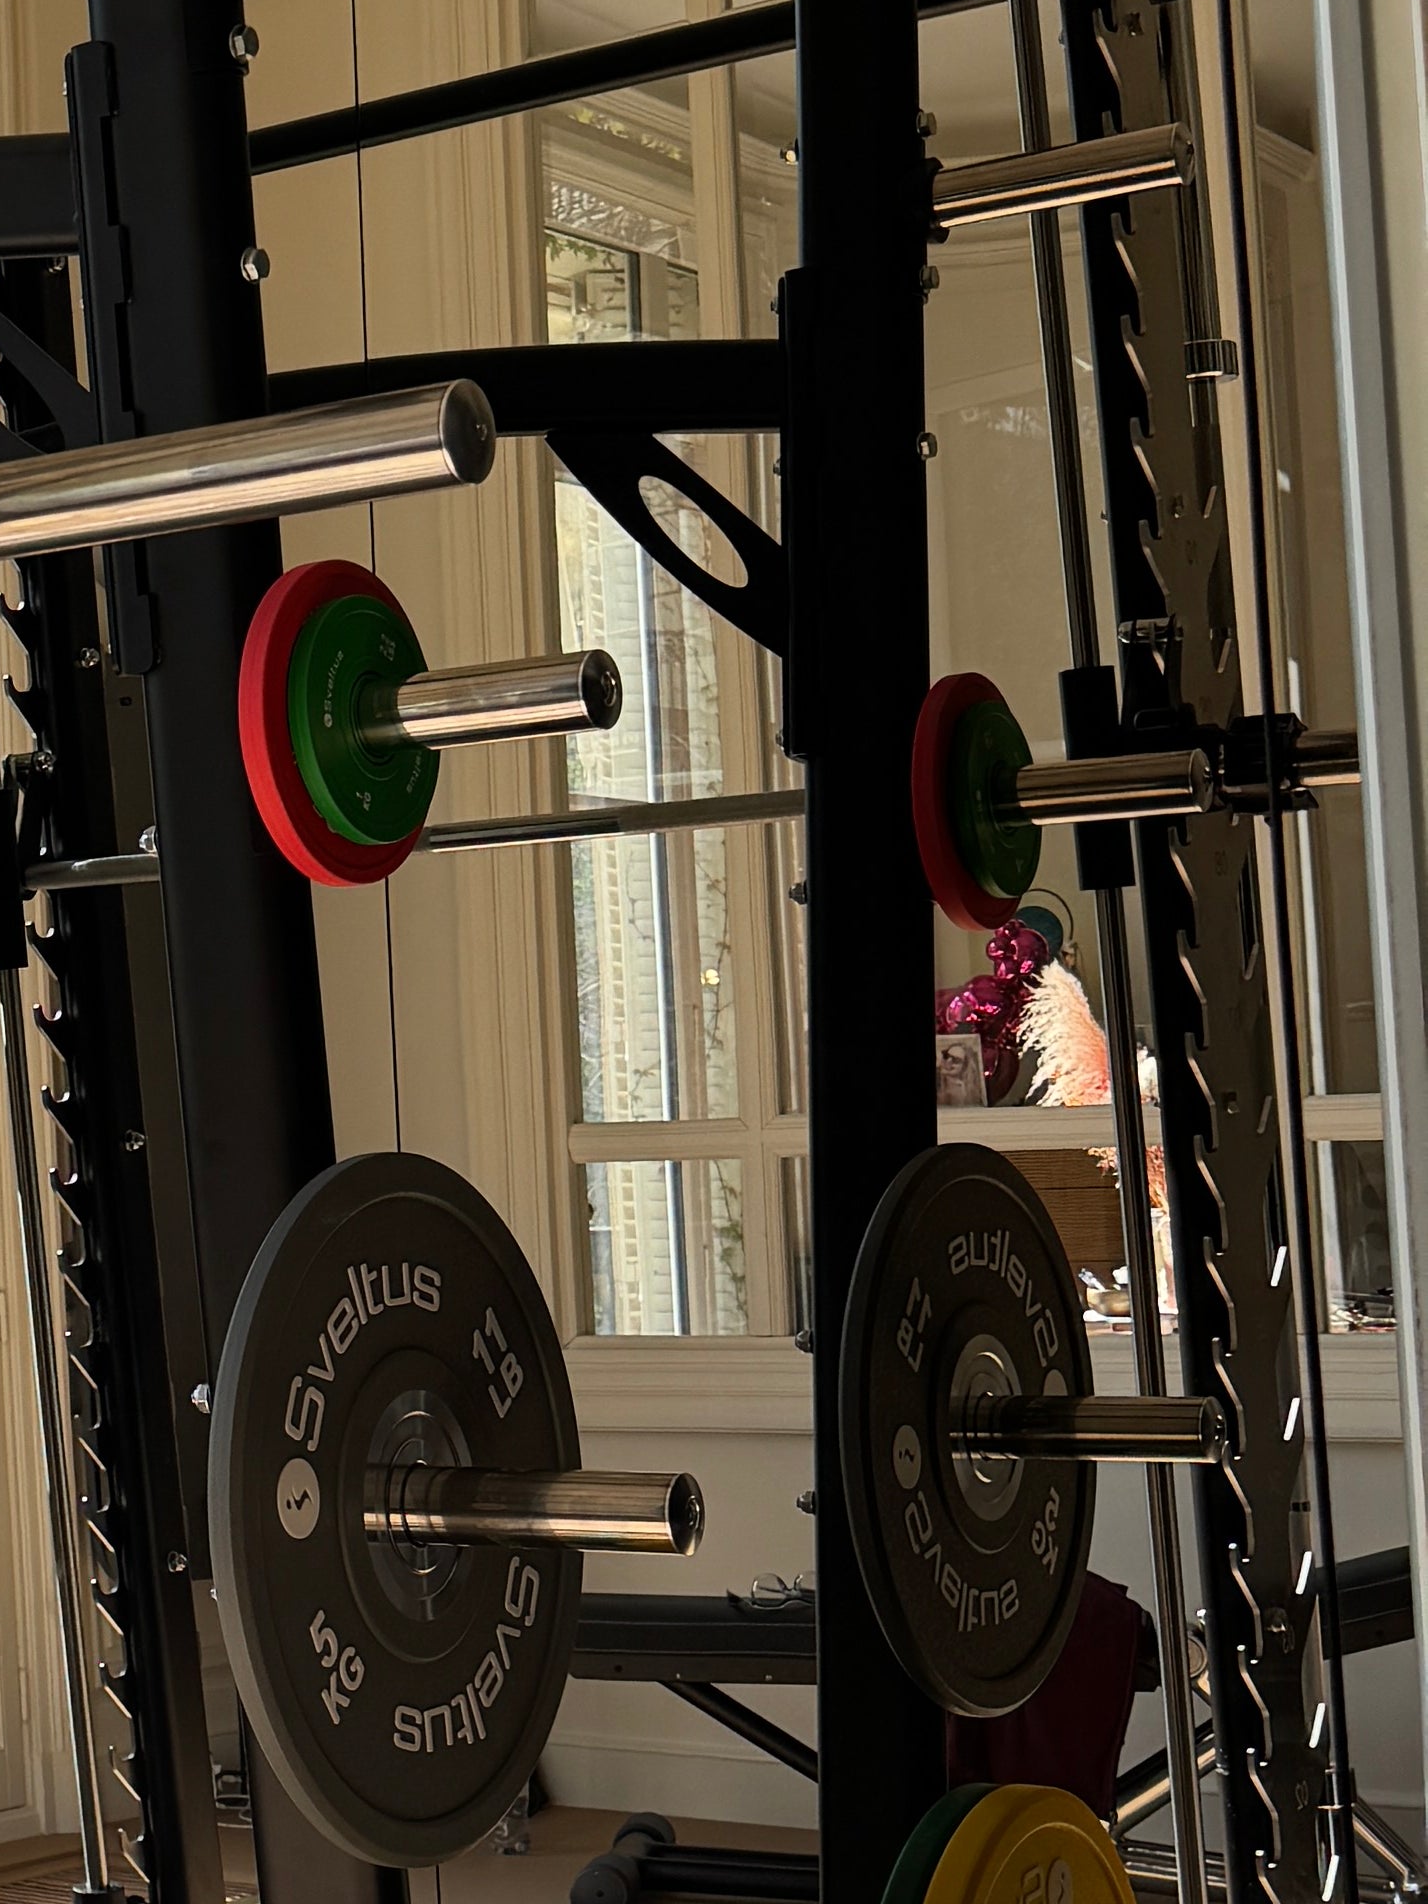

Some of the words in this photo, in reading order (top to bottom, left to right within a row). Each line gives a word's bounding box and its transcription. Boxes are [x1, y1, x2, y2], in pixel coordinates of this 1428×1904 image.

[285, 1261, 443, 1453] Sveltus
[471, 1307, 511, 1374] 11
[487, 1354, 525, 1420] LB
[310, 1609, 339, 1668] 5
[394, 1556, 541, 1753] Sveltus
[321, 1646, 365, 1725] KG
